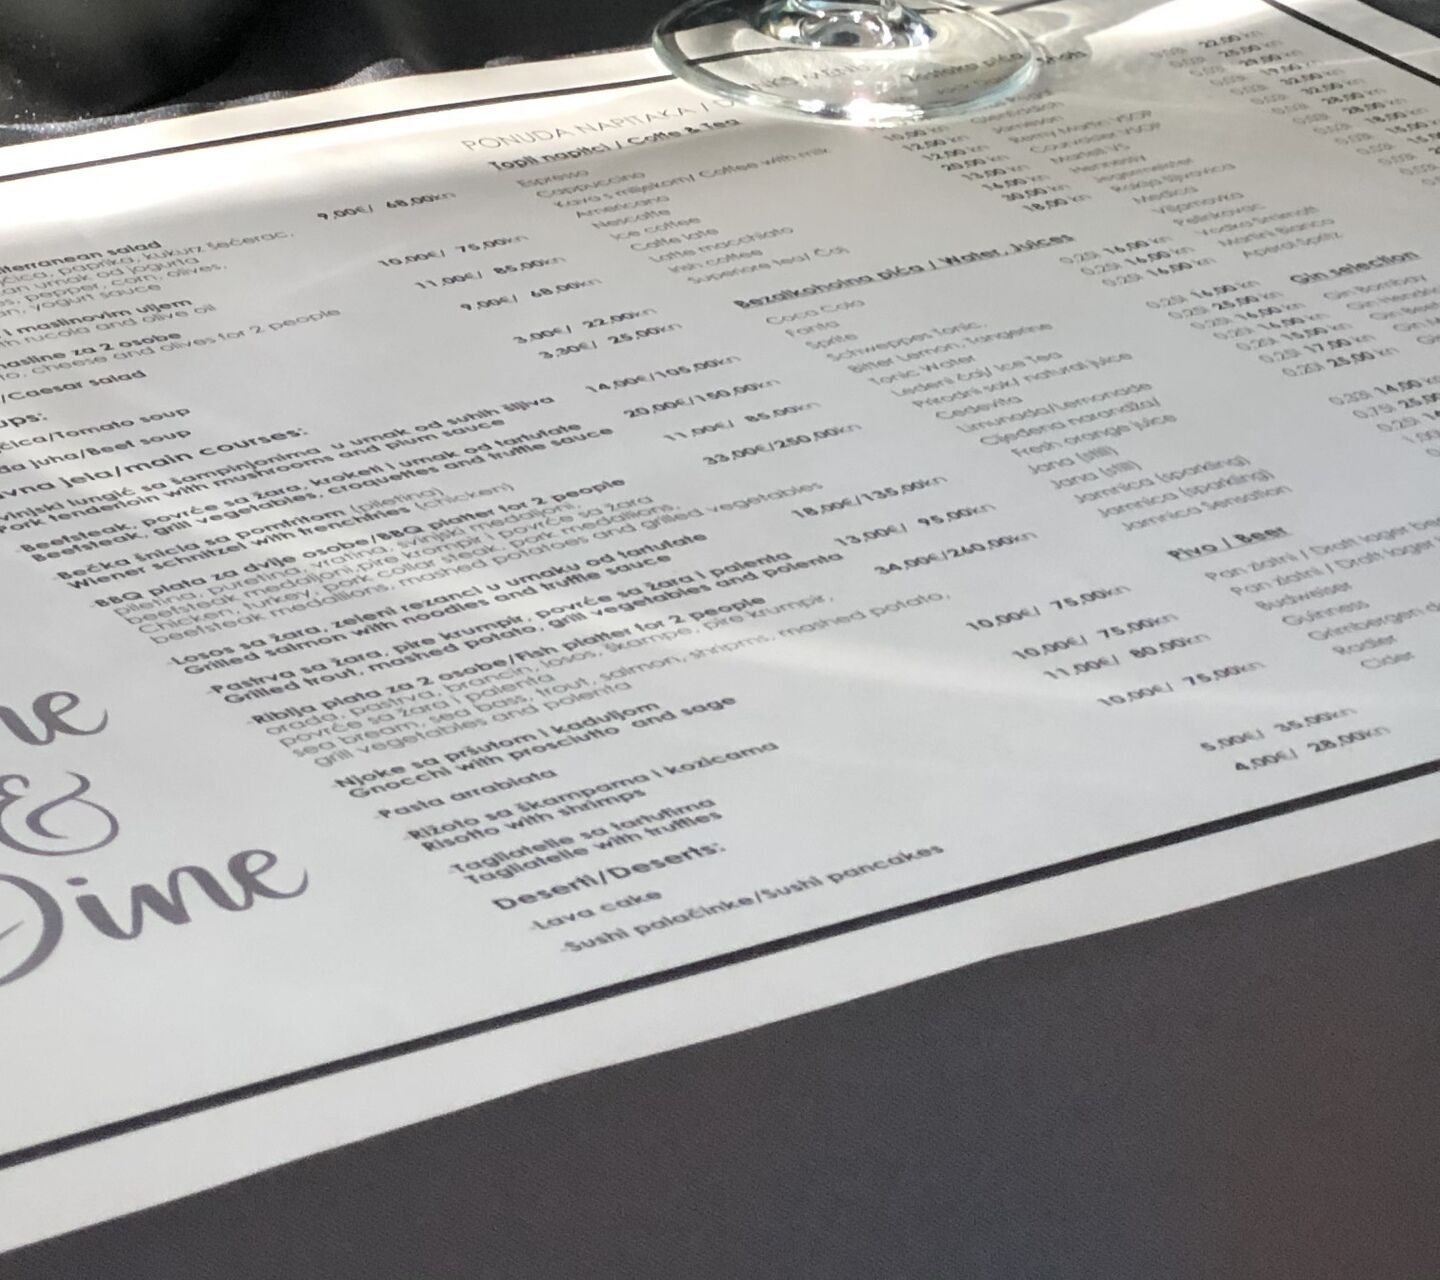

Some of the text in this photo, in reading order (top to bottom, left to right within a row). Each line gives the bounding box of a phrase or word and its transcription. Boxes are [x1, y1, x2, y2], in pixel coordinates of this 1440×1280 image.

[461, 127, 573, 150] PONUDA
[106, 240, 162, 256] salad
[16, 309, 131, 334] maslinovim
[135, 299, 192, 313] uljem
[70, 346, 97, 356] za
[98, 342, 114, 351] 2
[118, 332, 181, 348] osobe
[88, 369, 146, 386] salad
[138, 408, 190, 423] soup
[139, 429, 191, 445] soup
[47, 494, 159, 521] tenderloin
[162, 483, 208, 497] with
[212, 455, 334, 486] mushrooms
[338, 443, 381, 458] and
[384, 433, 438, 450] plum
[441, 418, 505, 437] sauce
[152, 520, 192, 536] grill
[327, 466, 439, 494] croquettes
[443, 454, 486, 469] and
[487, 443, 546, 460] truffle
[549, 427, 613, 446] sauce
[66, 566, 145, 589] Wiener
[151, 541, 247, 570] schnitzel
[250, 531, 296, 546] with
[1166, 526, 1287, 560] Pivo Beer
[183, 554, 671, 674] Grilled salmon with noodles and truffle sauce
[223, 680, 300, 703] Grilled
[367, 642, 459, 671] mashed
[547, 611, 587, 629] grill
[591, 584, 711, 615] vegetables
[714, 570, 759, 587] and
[761, 552, 843, 578] polenta
[348, 696, 736, 798] Gnocchi with prosciutto and sage
[449, 769, 557, 801] arrabiata
[483, 808, 514, 821] sa
[515, 774, 649, 812] škampama
[663, 742, 778, 774] kozicama
[420, 788, 646, 851] Risotto with shrimps
[578, 826, 609, 840] sa
[609, 799, 715, 830] tartufima
[464, 811, 722, 884] Tagliatelle with truffles
[826, 845, 943, 883] pancakes
[599, 891, 662, 912] cake
